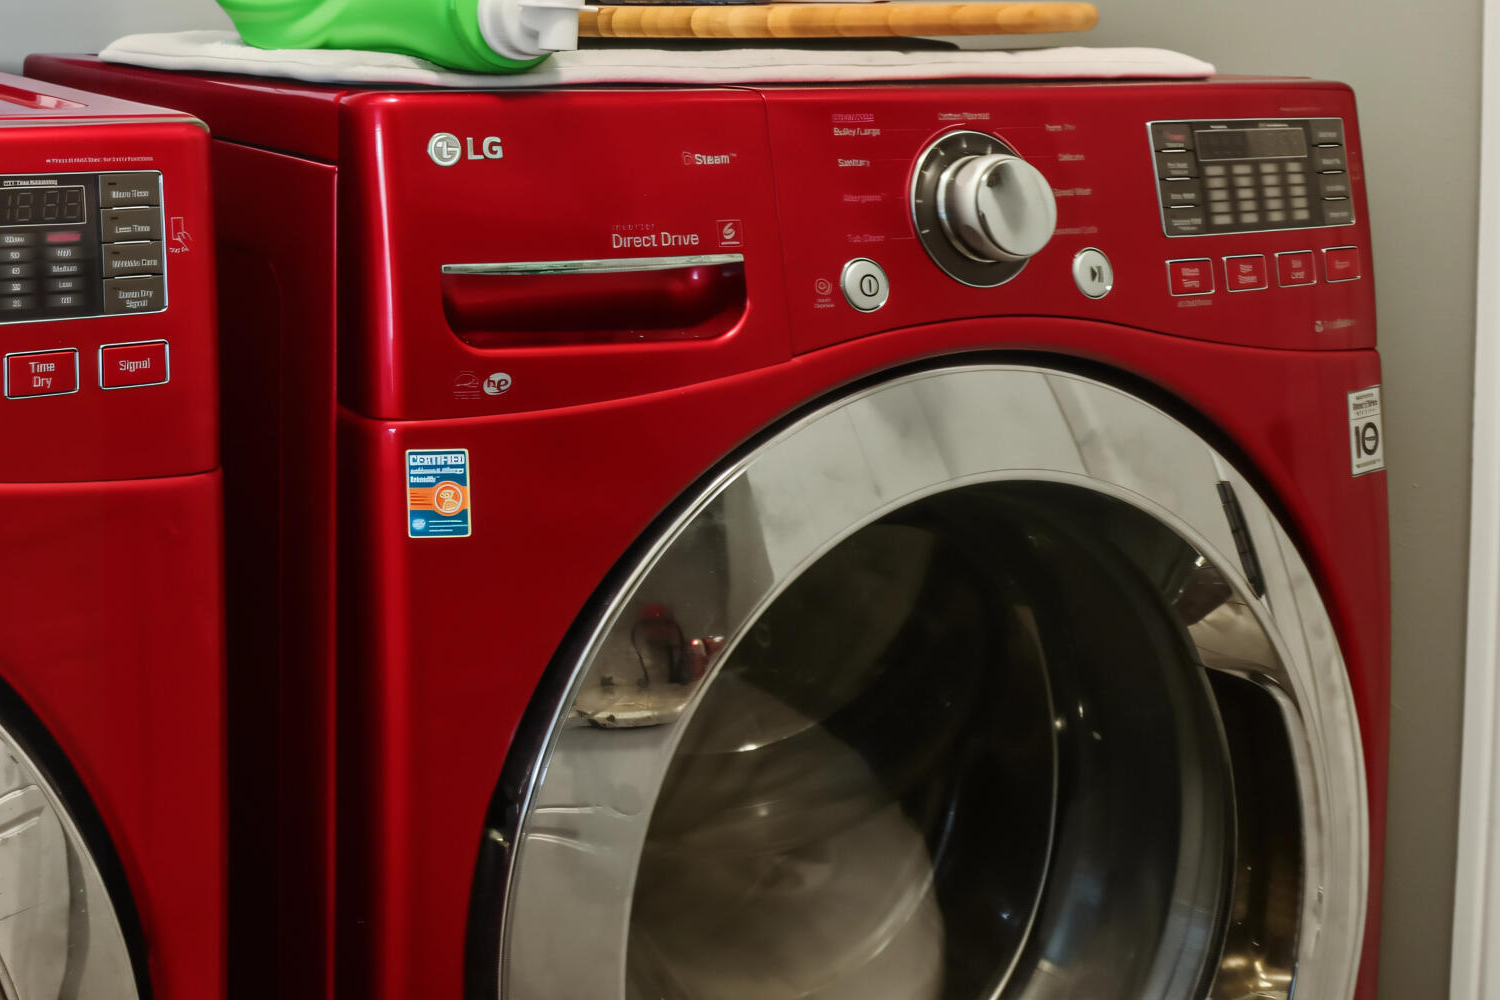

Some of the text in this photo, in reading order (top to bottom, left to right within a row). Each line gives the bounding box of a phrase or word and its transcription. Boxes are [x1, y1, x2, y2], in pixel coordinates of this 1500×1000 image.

[466, 136, 504, 160] LG
[612, 232, 699, 248] Direct Drive
[28, 361, 55, 374] Time
[118, 358, 151, 372] Signal
[33, 375, 52, 389] Dry
